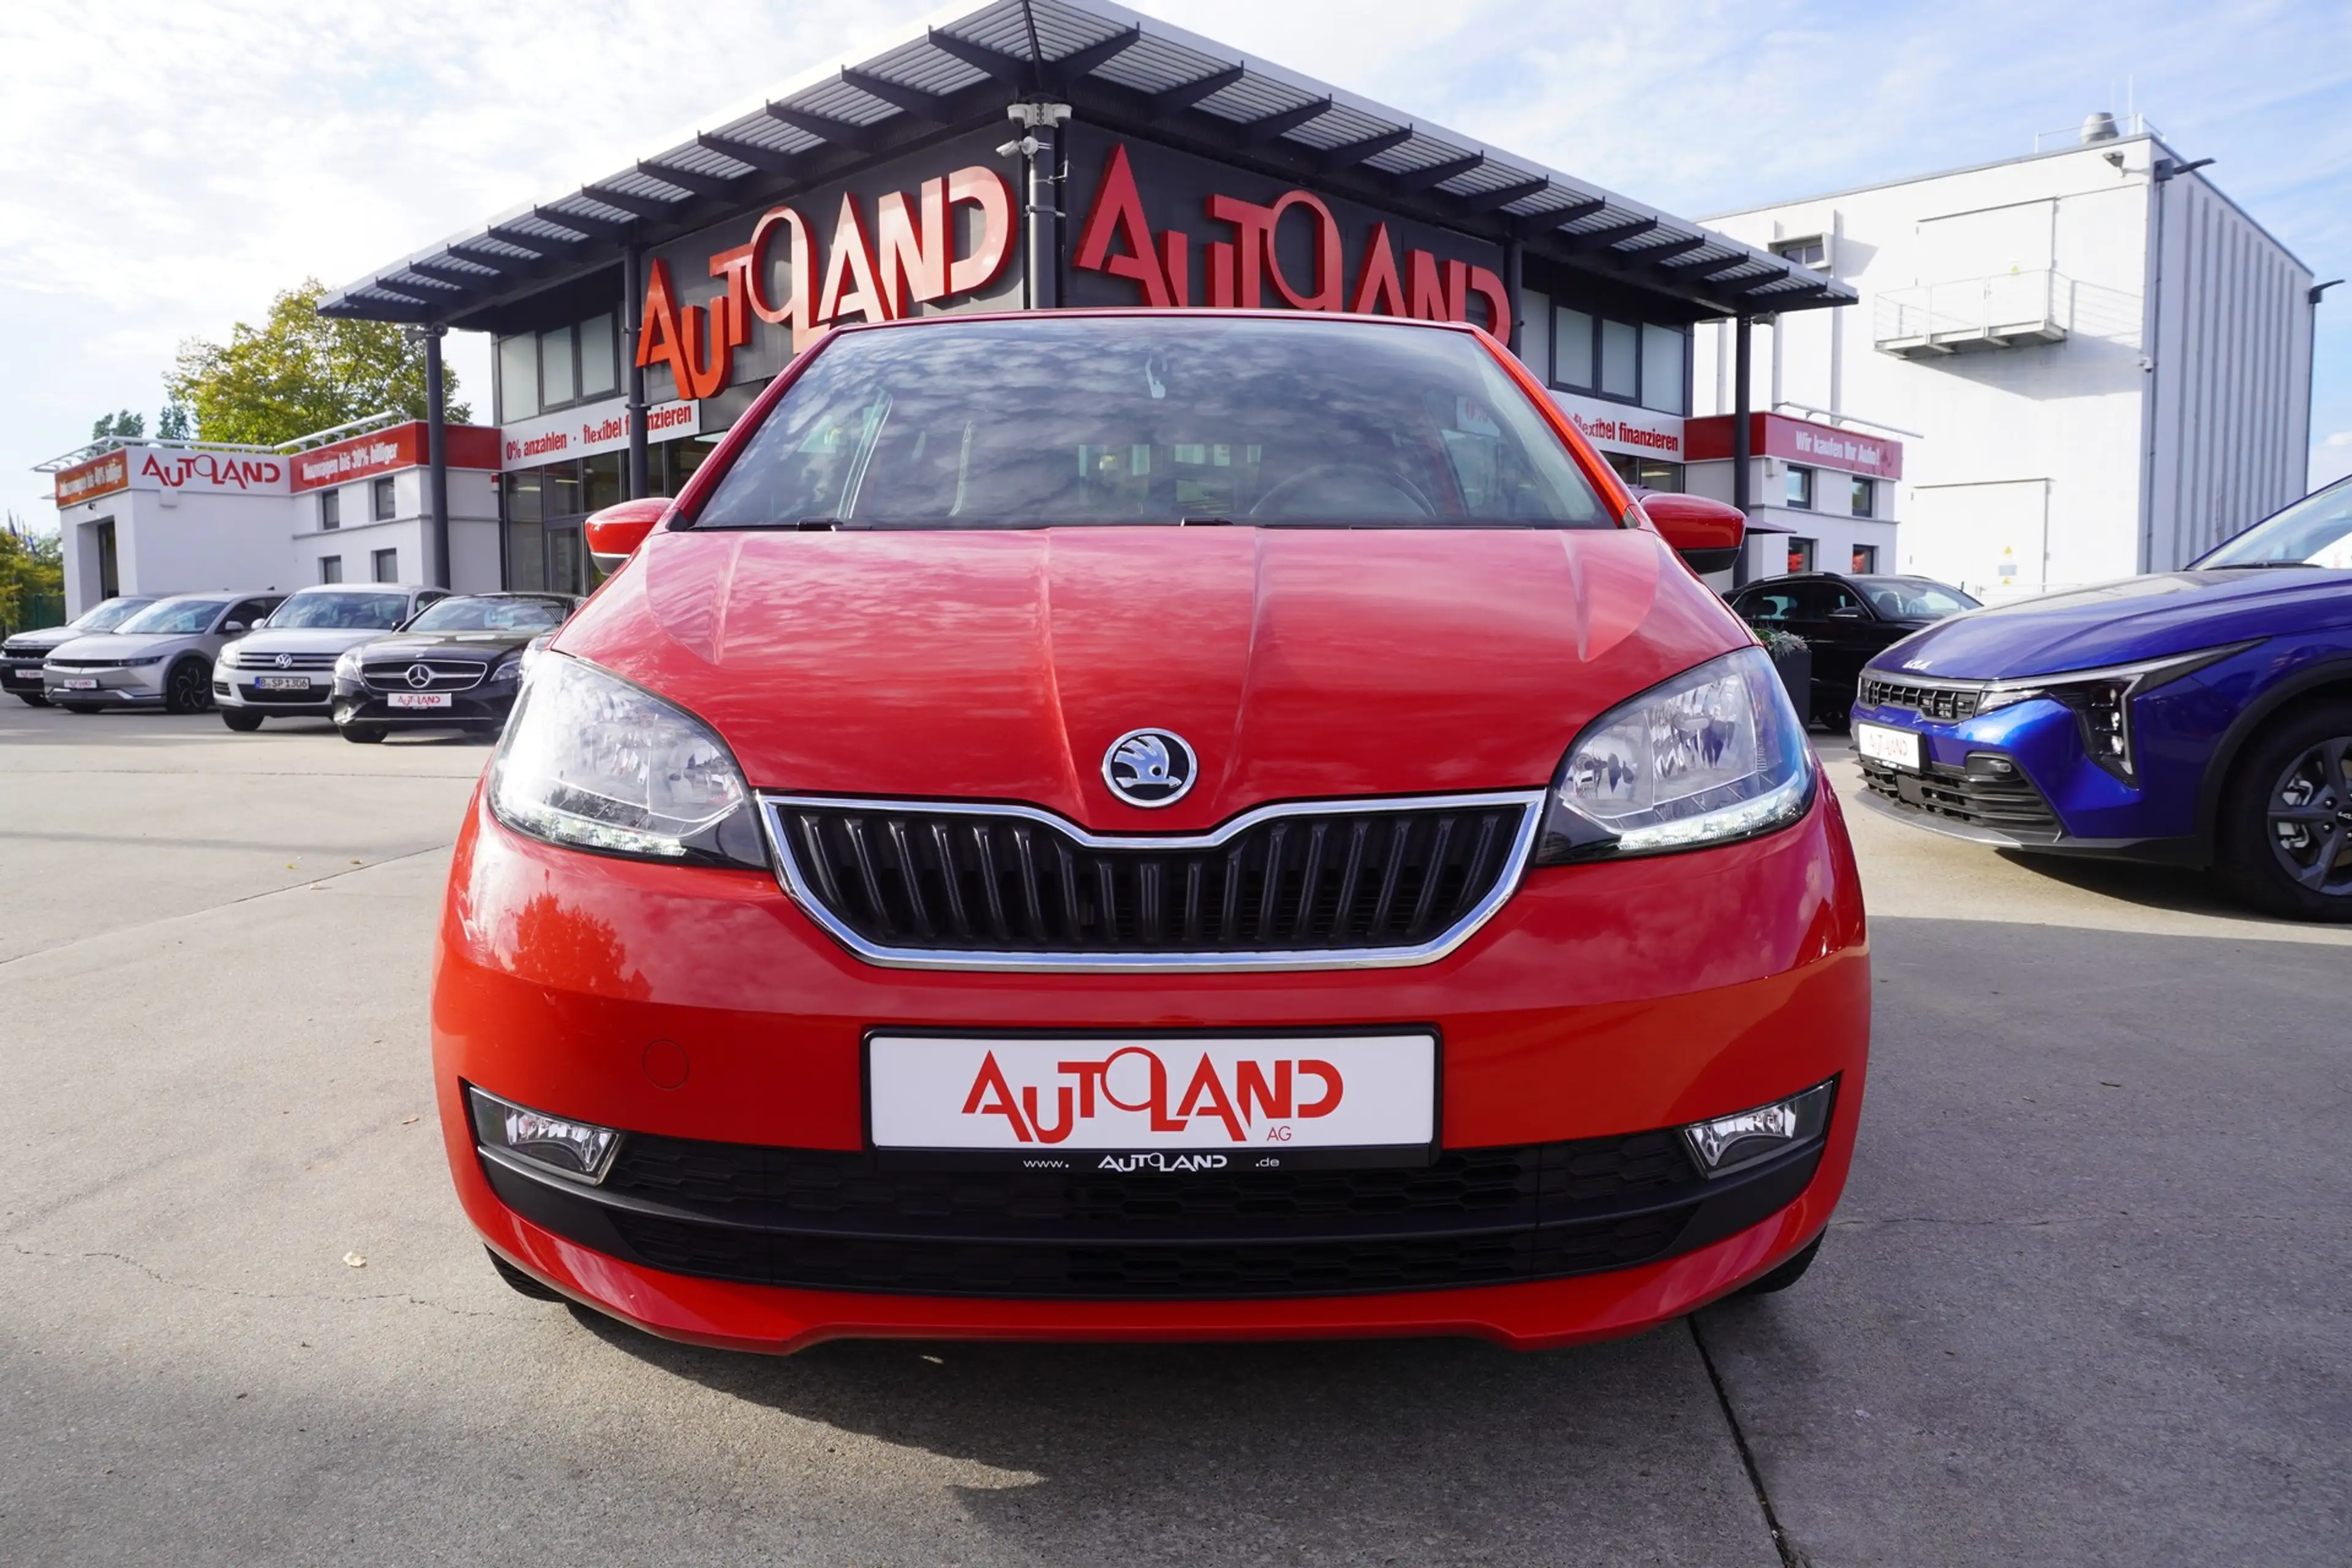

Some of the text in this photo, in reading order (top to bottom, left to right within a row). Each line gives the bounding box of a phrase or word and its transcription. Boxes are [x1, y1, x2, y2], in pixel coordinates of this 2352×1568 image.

[506, 405, 692, 460] 0% anzahlen flexibel fnzieren
[1618, 421, 1678, 452] finanzieren
[1796, 431, 1812, 451] Wir
[1814, 434, 1843, 458] kaufen
[1858, 443, 1880, 466] Auto!
[141, 453, 281, 490] AUTOLAND
[398, 695, 441, 706] AUTLAND
[961, 1046, 1344, 1144] AUTOLAND
[1266, 1125, 1292, 1142] AG
[1097, 1152, 1227, 1172] AUTOLAND
